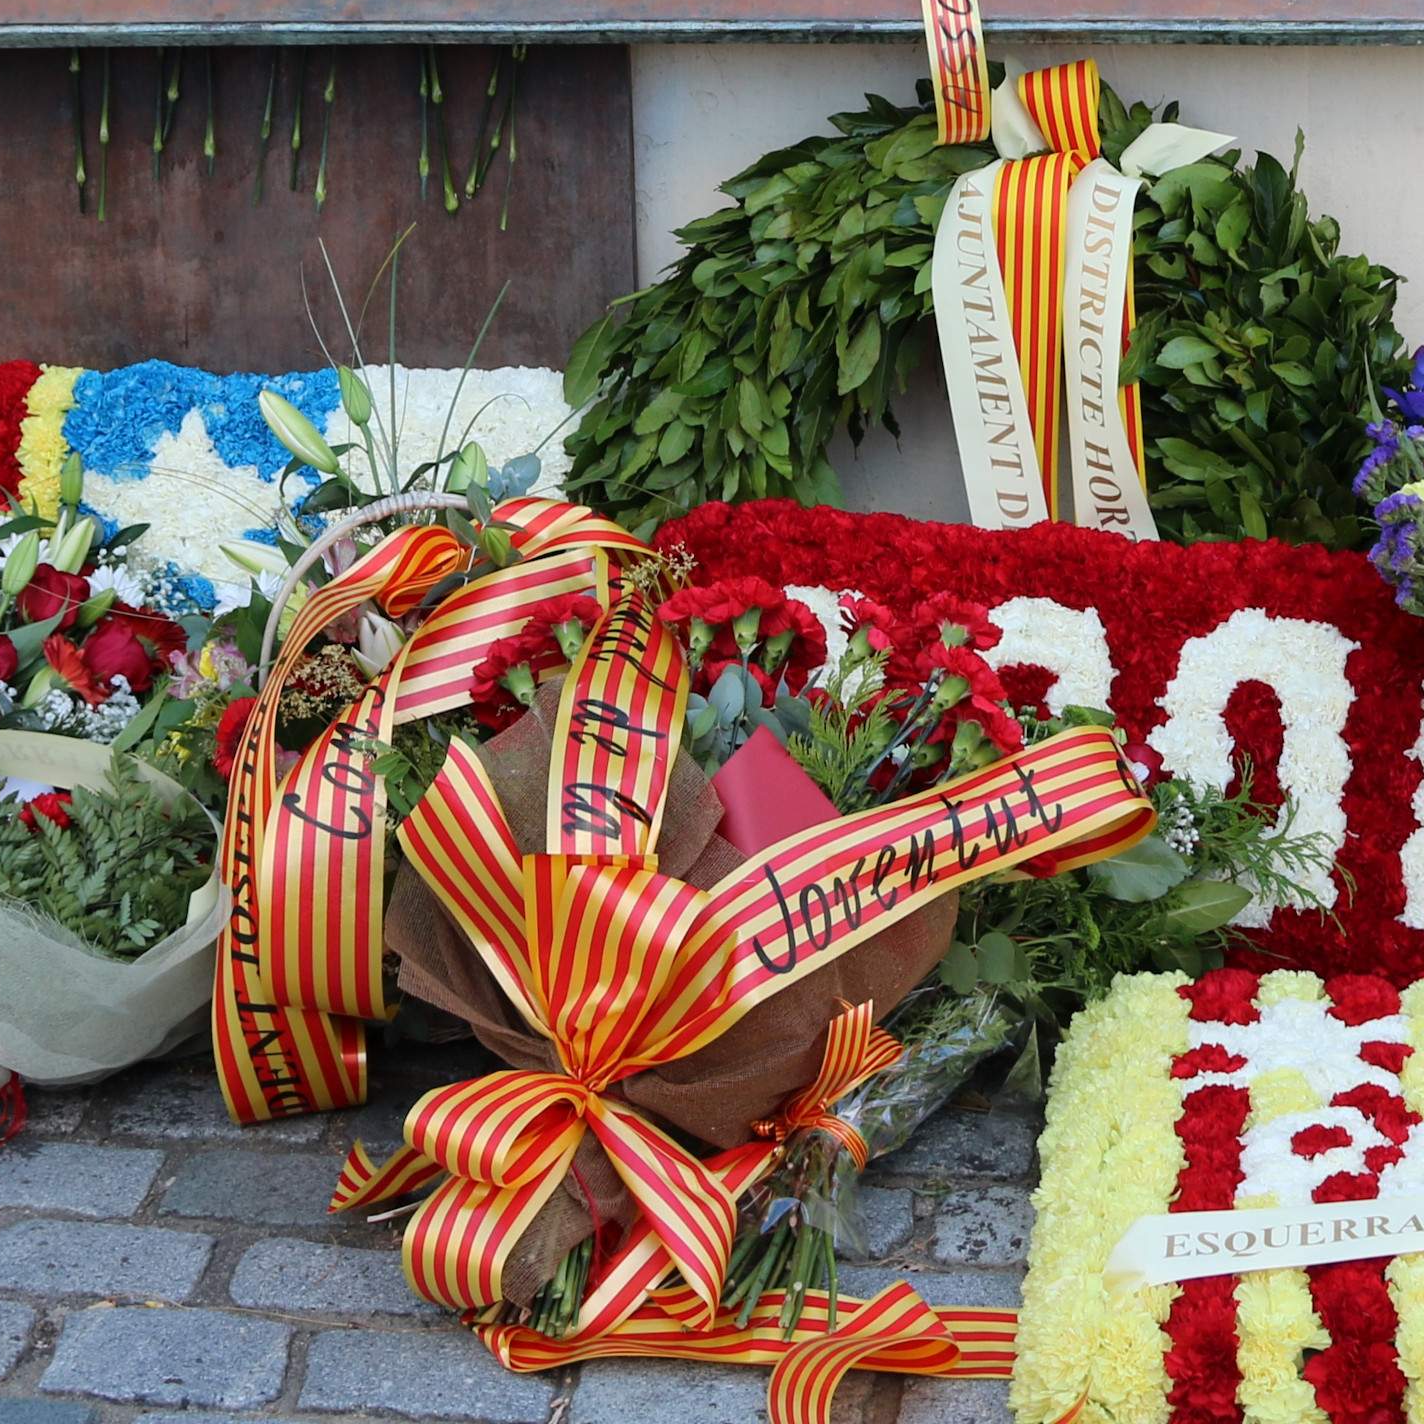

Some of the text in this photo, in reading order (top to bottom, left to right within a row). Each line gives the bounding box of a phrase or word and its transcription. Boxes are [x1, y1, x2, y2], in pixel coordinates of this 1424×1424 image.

[956, 177, 1025, 479] AJUNTAMENT
[1078, 181, 1122, 429] DISTRICTE
[561, 781, 653, 840] la
[569, 698, 667, 757] de
[230, 794, 261, 977] JOSEP
[752, 762, 1064, 976] Joventut
